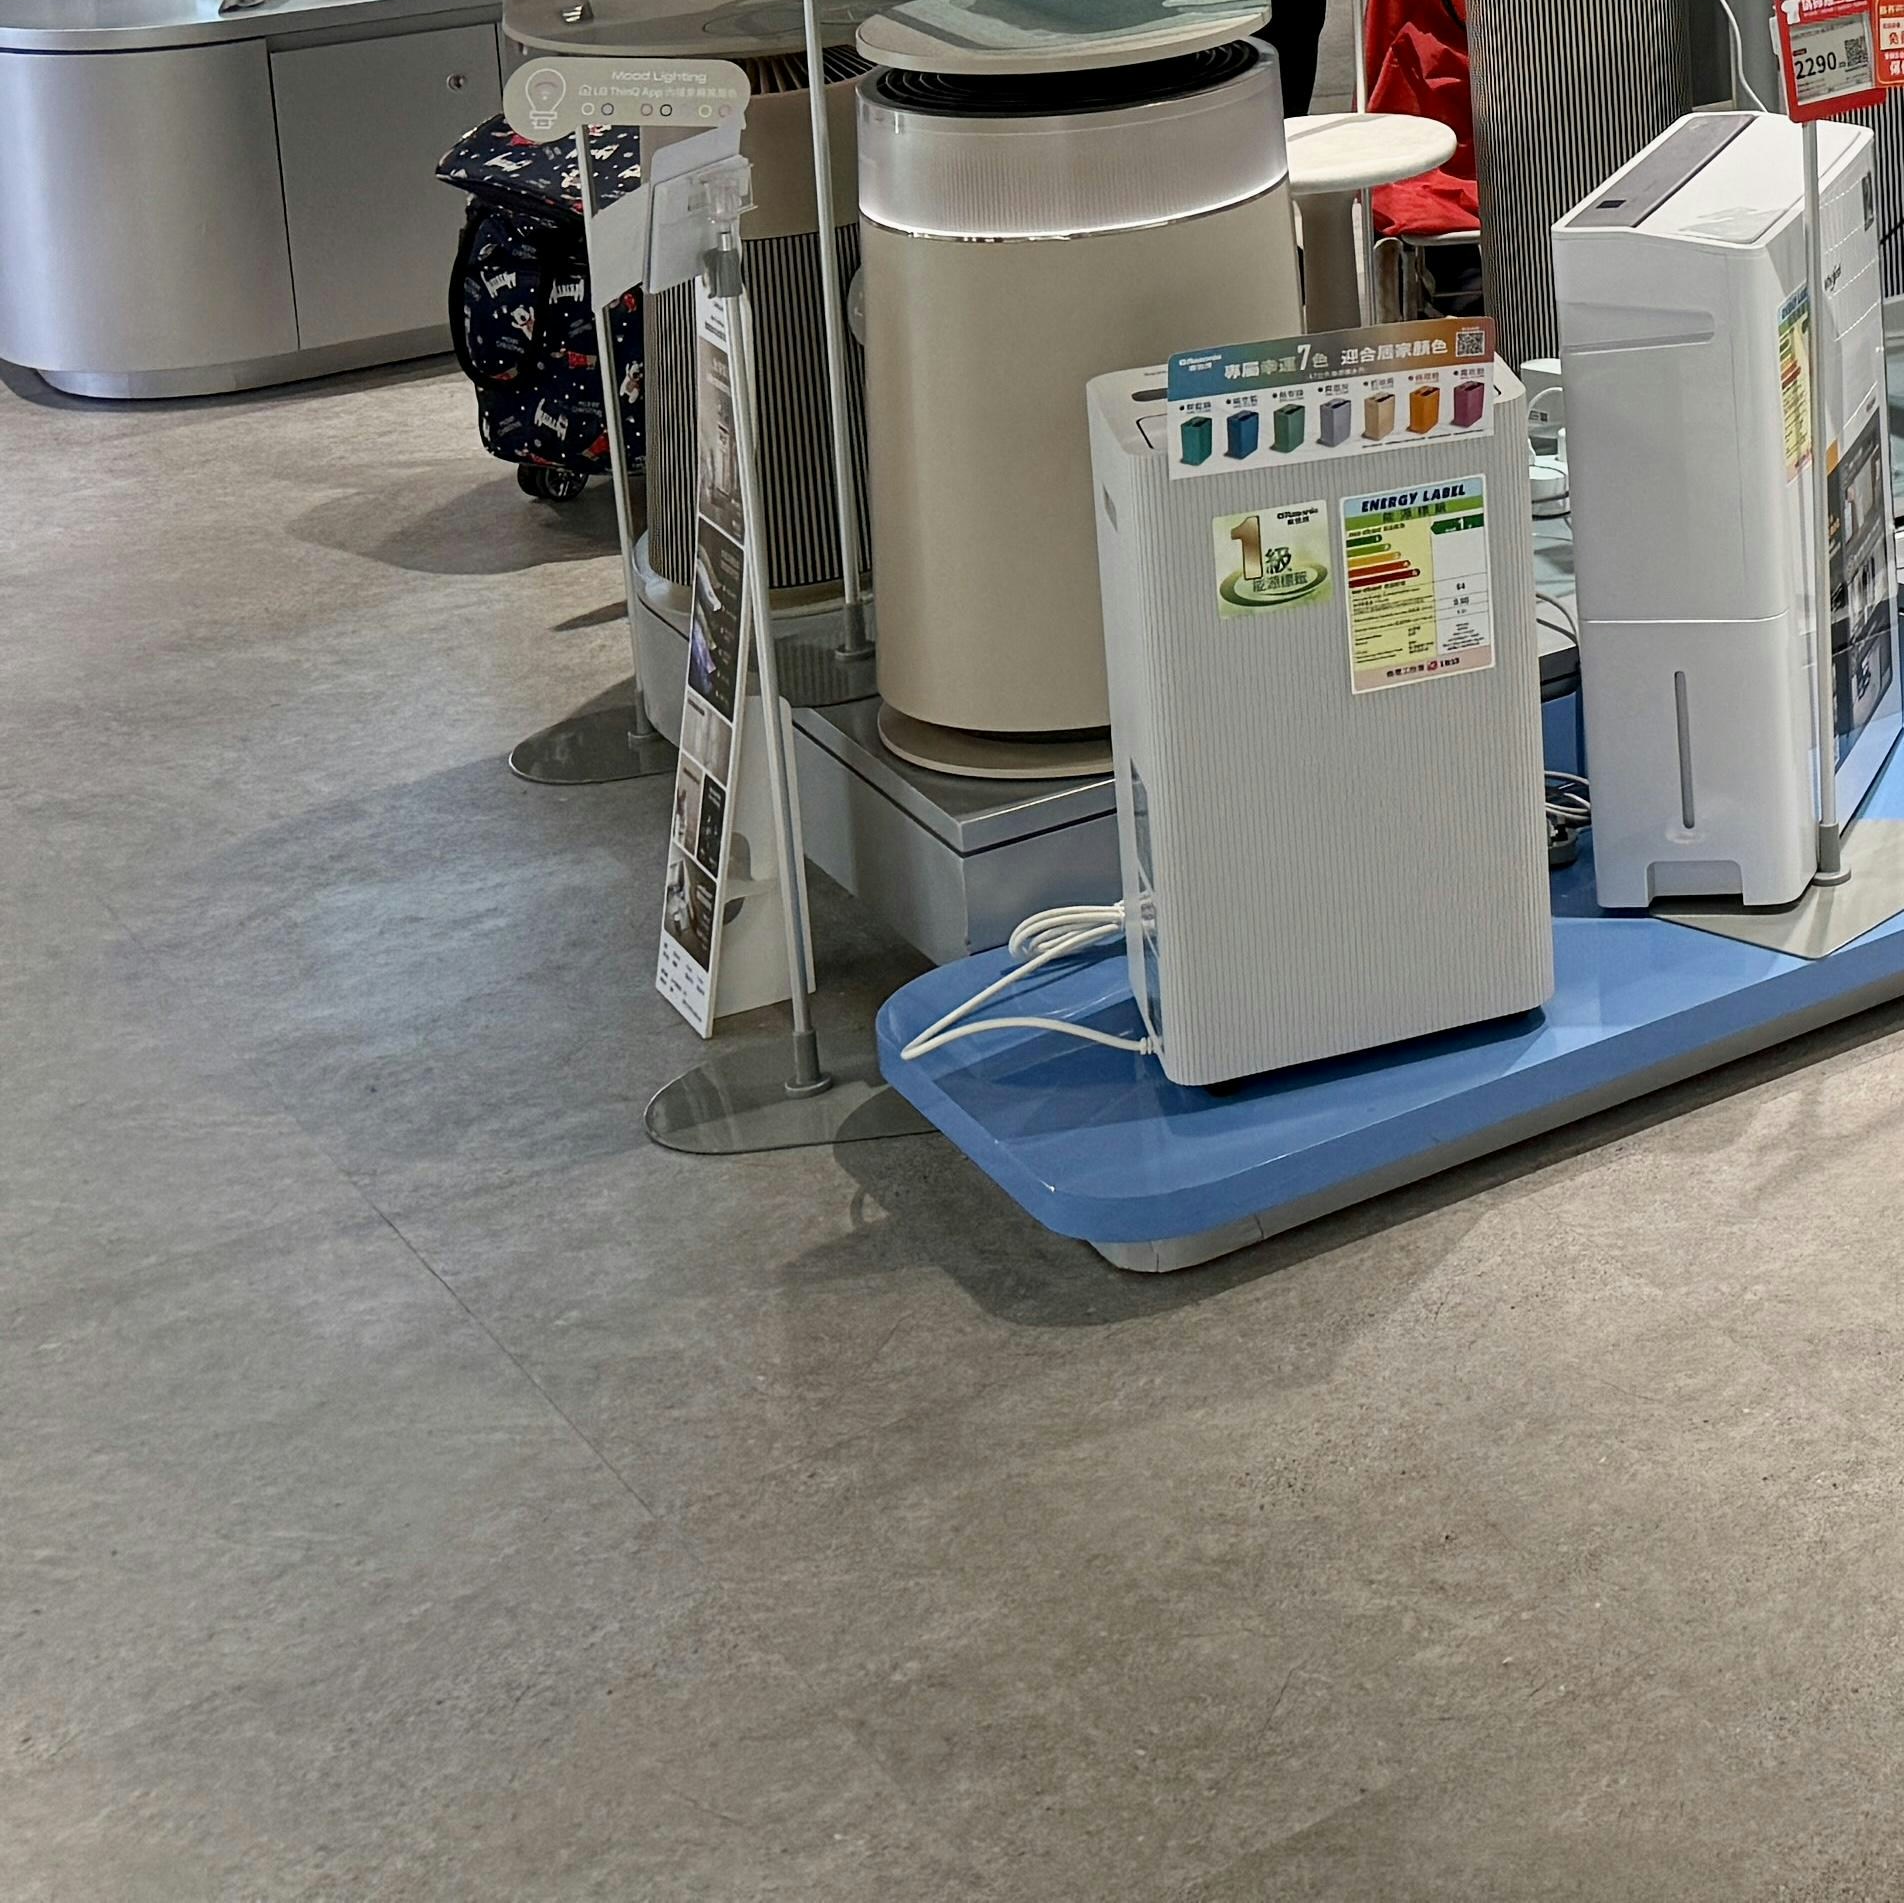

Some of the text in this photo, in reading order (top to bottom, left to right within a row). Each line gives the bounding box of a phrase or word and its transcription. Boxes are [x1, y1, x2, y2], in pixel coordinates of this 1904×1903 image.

[612, 70, 707, 87] Mood Lighting
[1795, 51, 1838, 81] 2290
[1361, 484, 1467, 514] ENERGY LABEL
